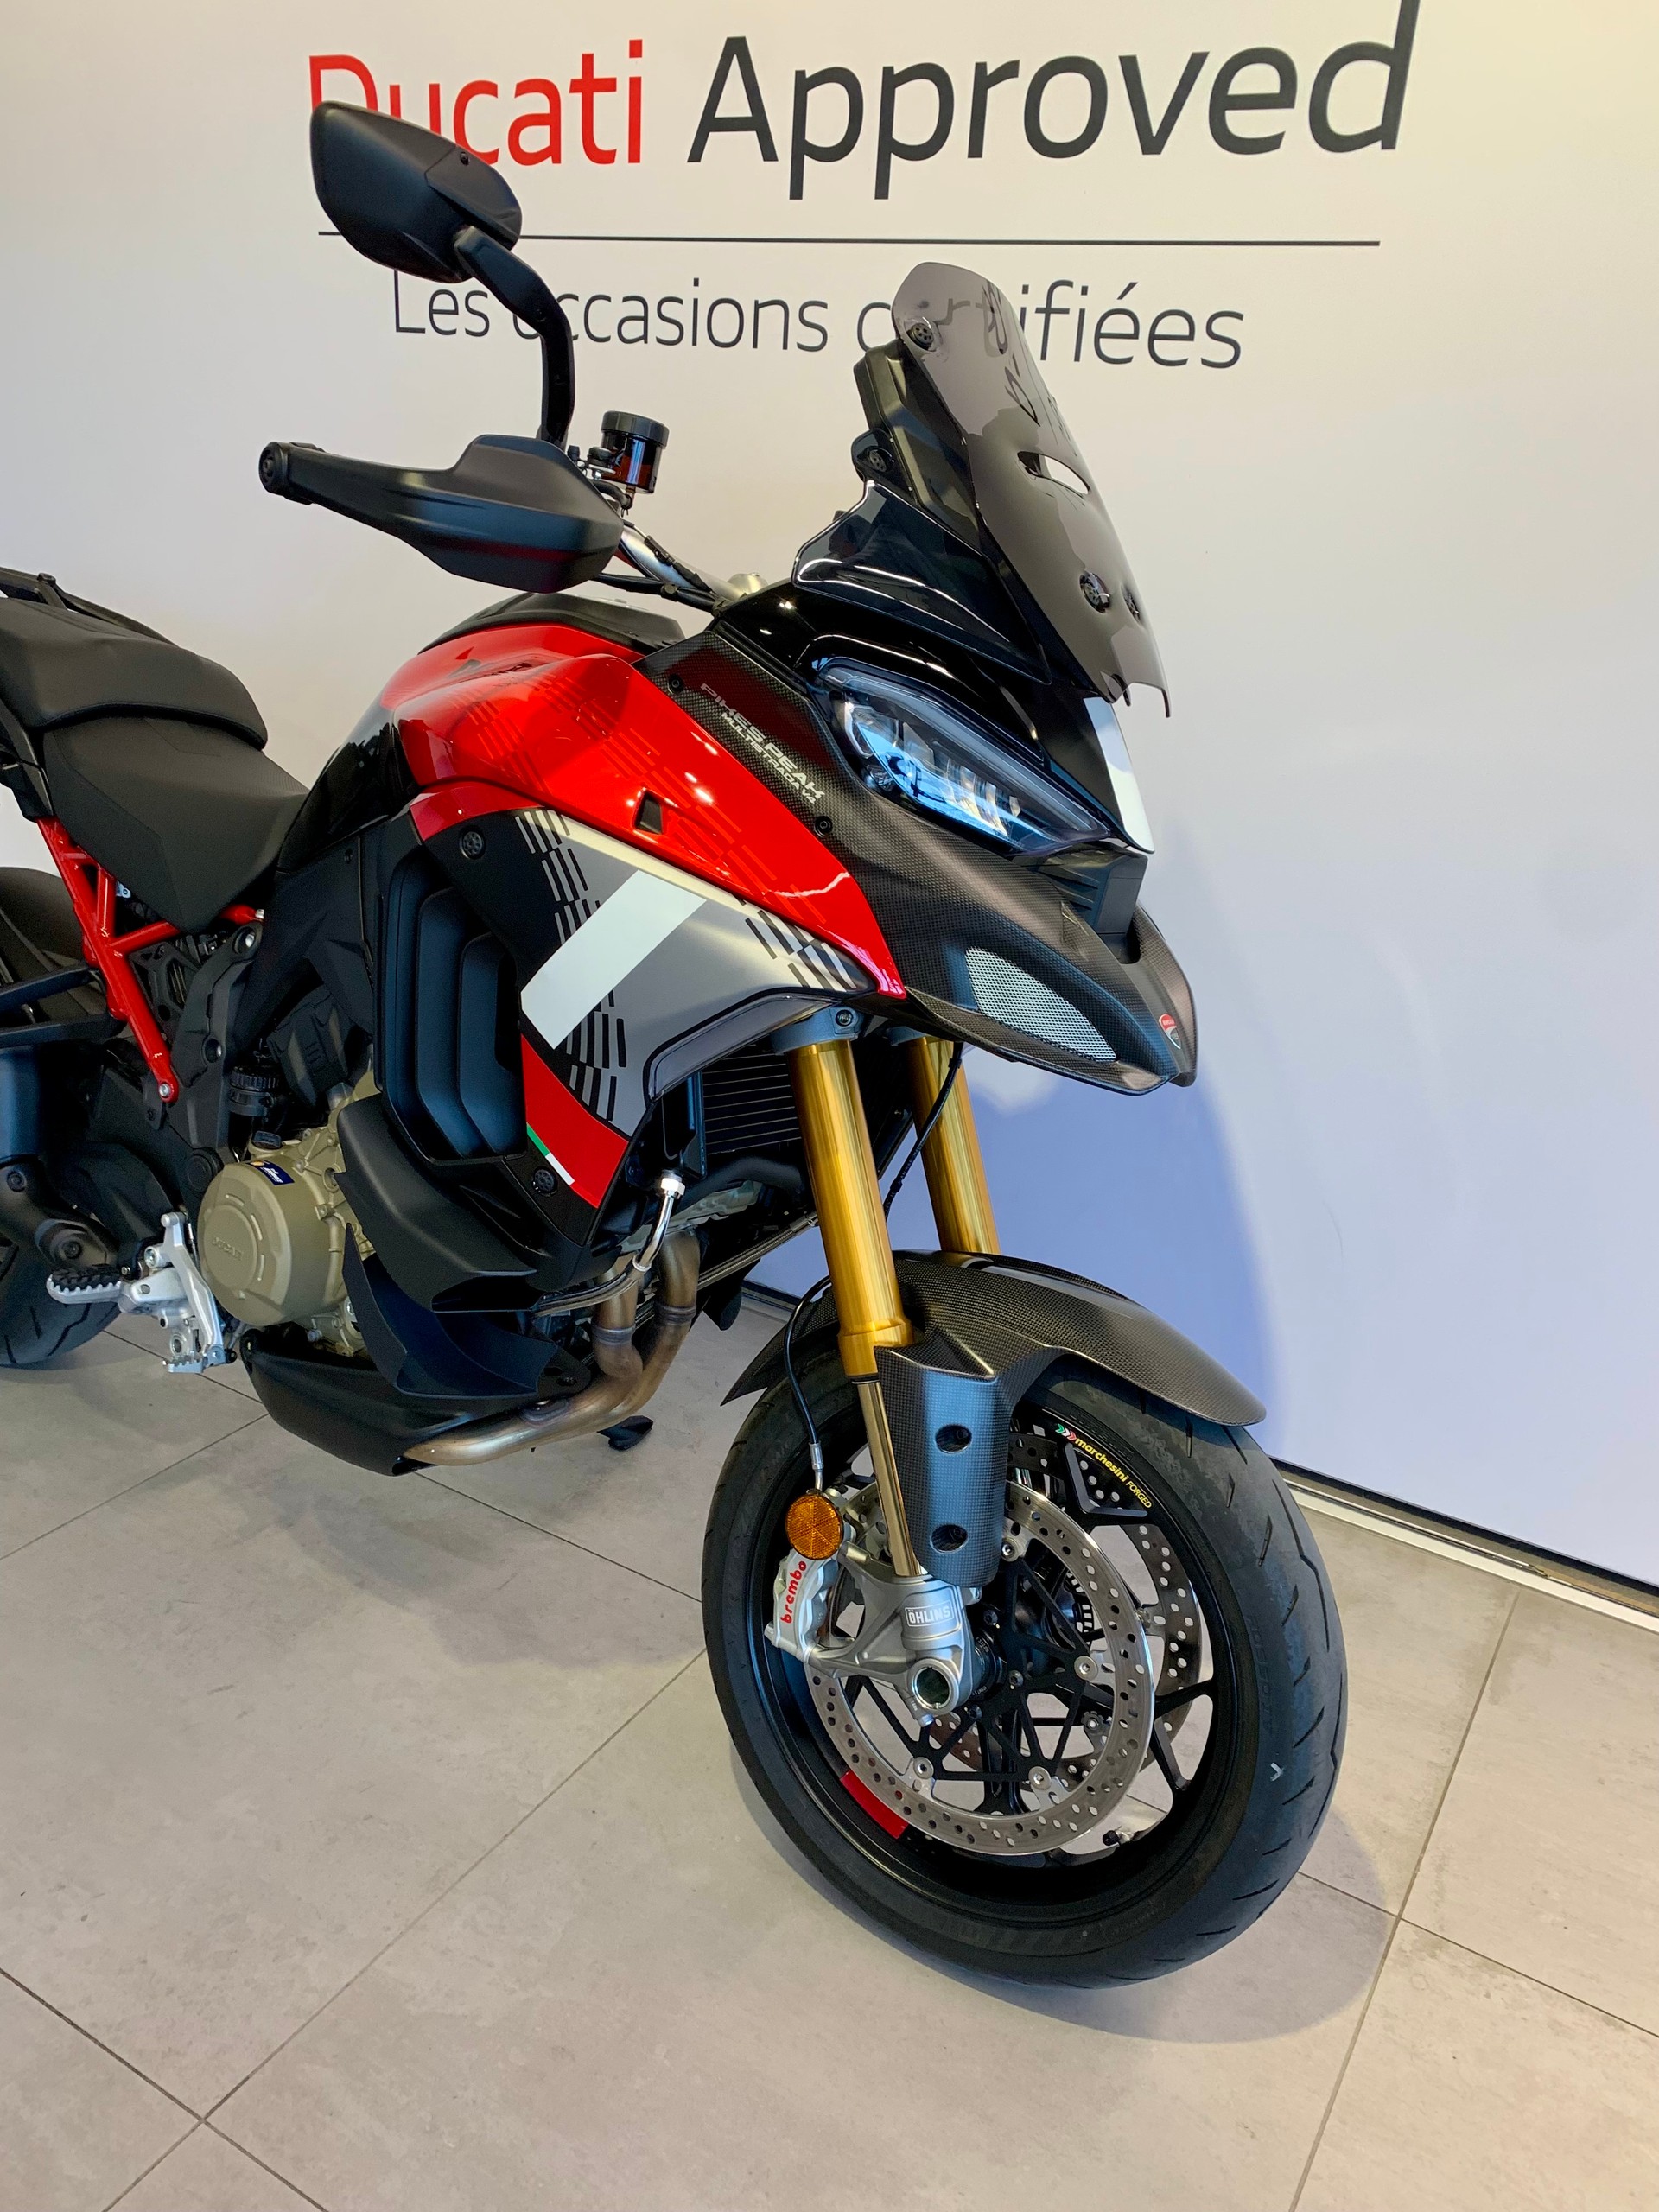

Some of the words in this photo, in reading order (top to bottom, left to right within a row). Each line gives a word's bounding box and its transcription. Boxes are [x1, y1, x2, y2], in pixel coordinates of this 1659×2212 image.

[687, 0, 1421, 200] Approved
[394, 270, 490, 338] Les
[700, 683, 766, 743] PIKES
[764, 742, 825, 799] PEAK
[721, 712, 800, 791] MULTISTRADA
[801, 788, 817, 804] V4
[1075, 1438, 1130, 1483] marchesini
[1126, 1480, 1153, 1509] FORGED
[780, 1560, 807, 1624] brembo
[907, 1605, 951, 1624] ÖHLINS
